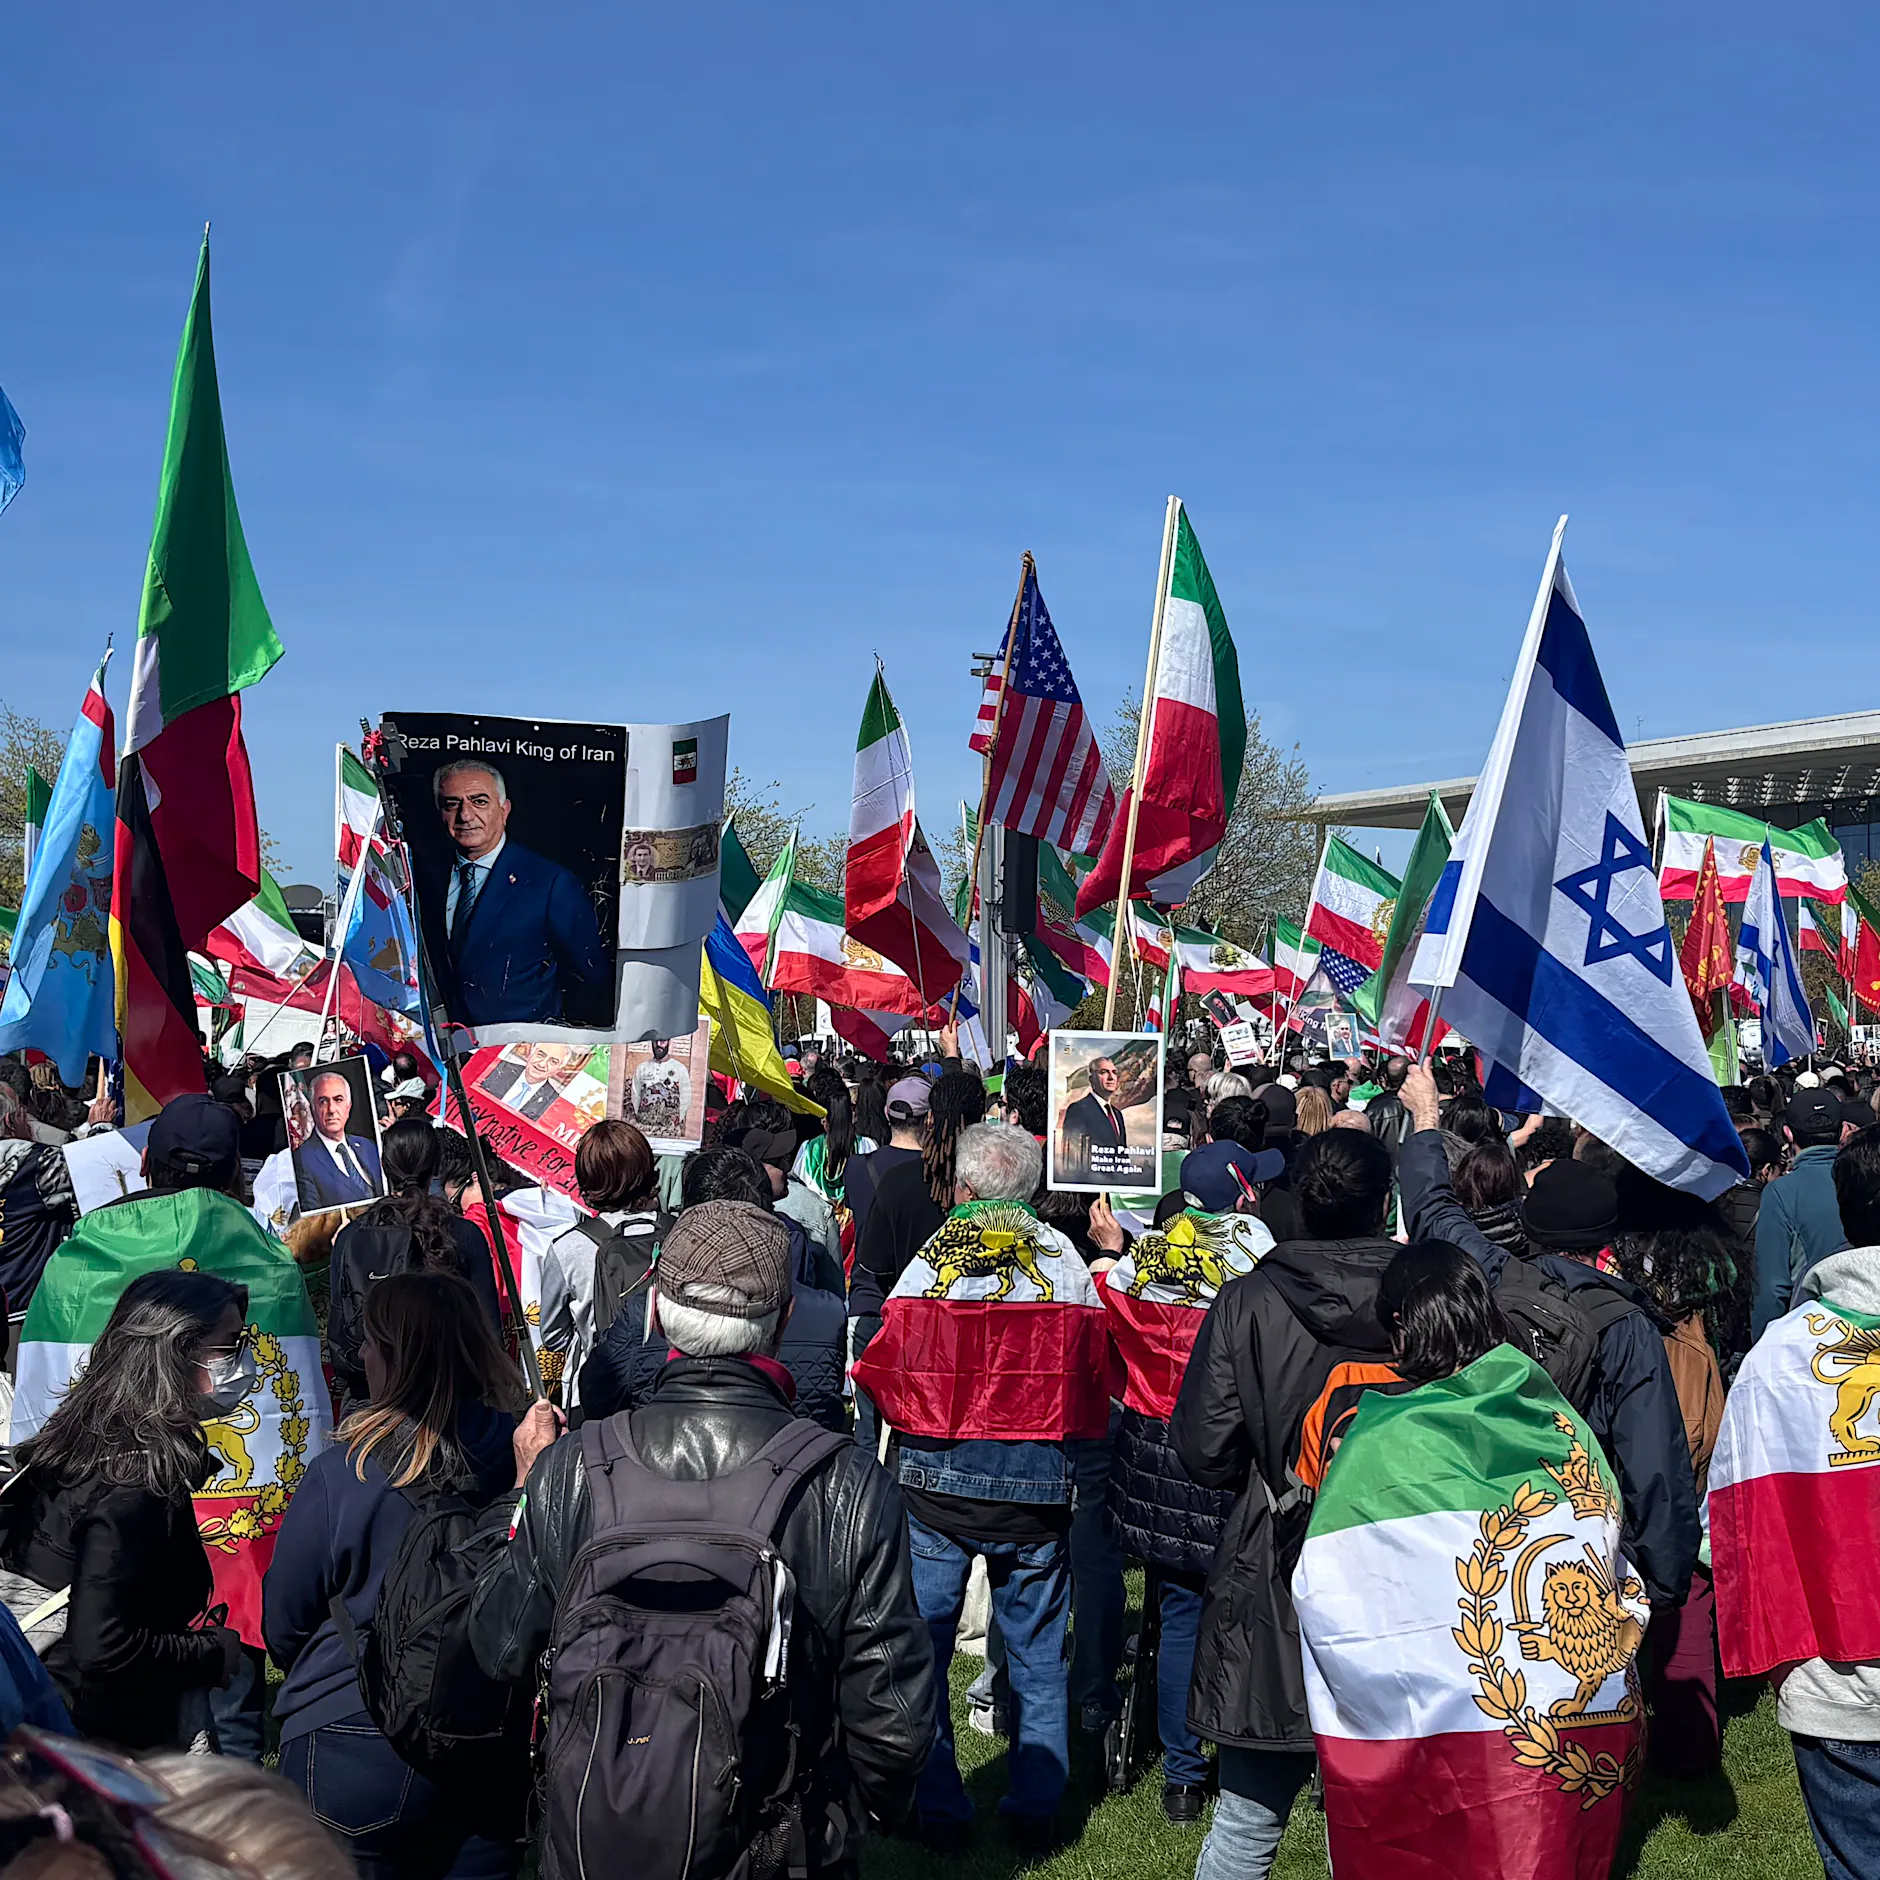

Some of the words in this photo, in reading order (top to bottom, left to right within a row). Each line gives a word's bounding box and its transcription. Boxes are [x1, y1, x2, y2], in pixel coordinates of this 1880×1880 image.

[398, 733, 440, 749] Reza
[447, 734, 510, 753] Pahlavi
[516, 739, 554, 761] King
[560, 744, 577, 760] of
[582, 747, 615, 762] Iran
[1091, 1144, 1115, 1154] Reza
[1117, 1145, 1155, 1156] Pahlavi
[537, 1147, 572, 1174] for
[1091, 1155, 1113, 1163] Make
[1114, 1156, 1131, 1164] Iran
[1091, 1163, 1115, 1172] Great
[1116, 1164, 1142, 1175] Again
